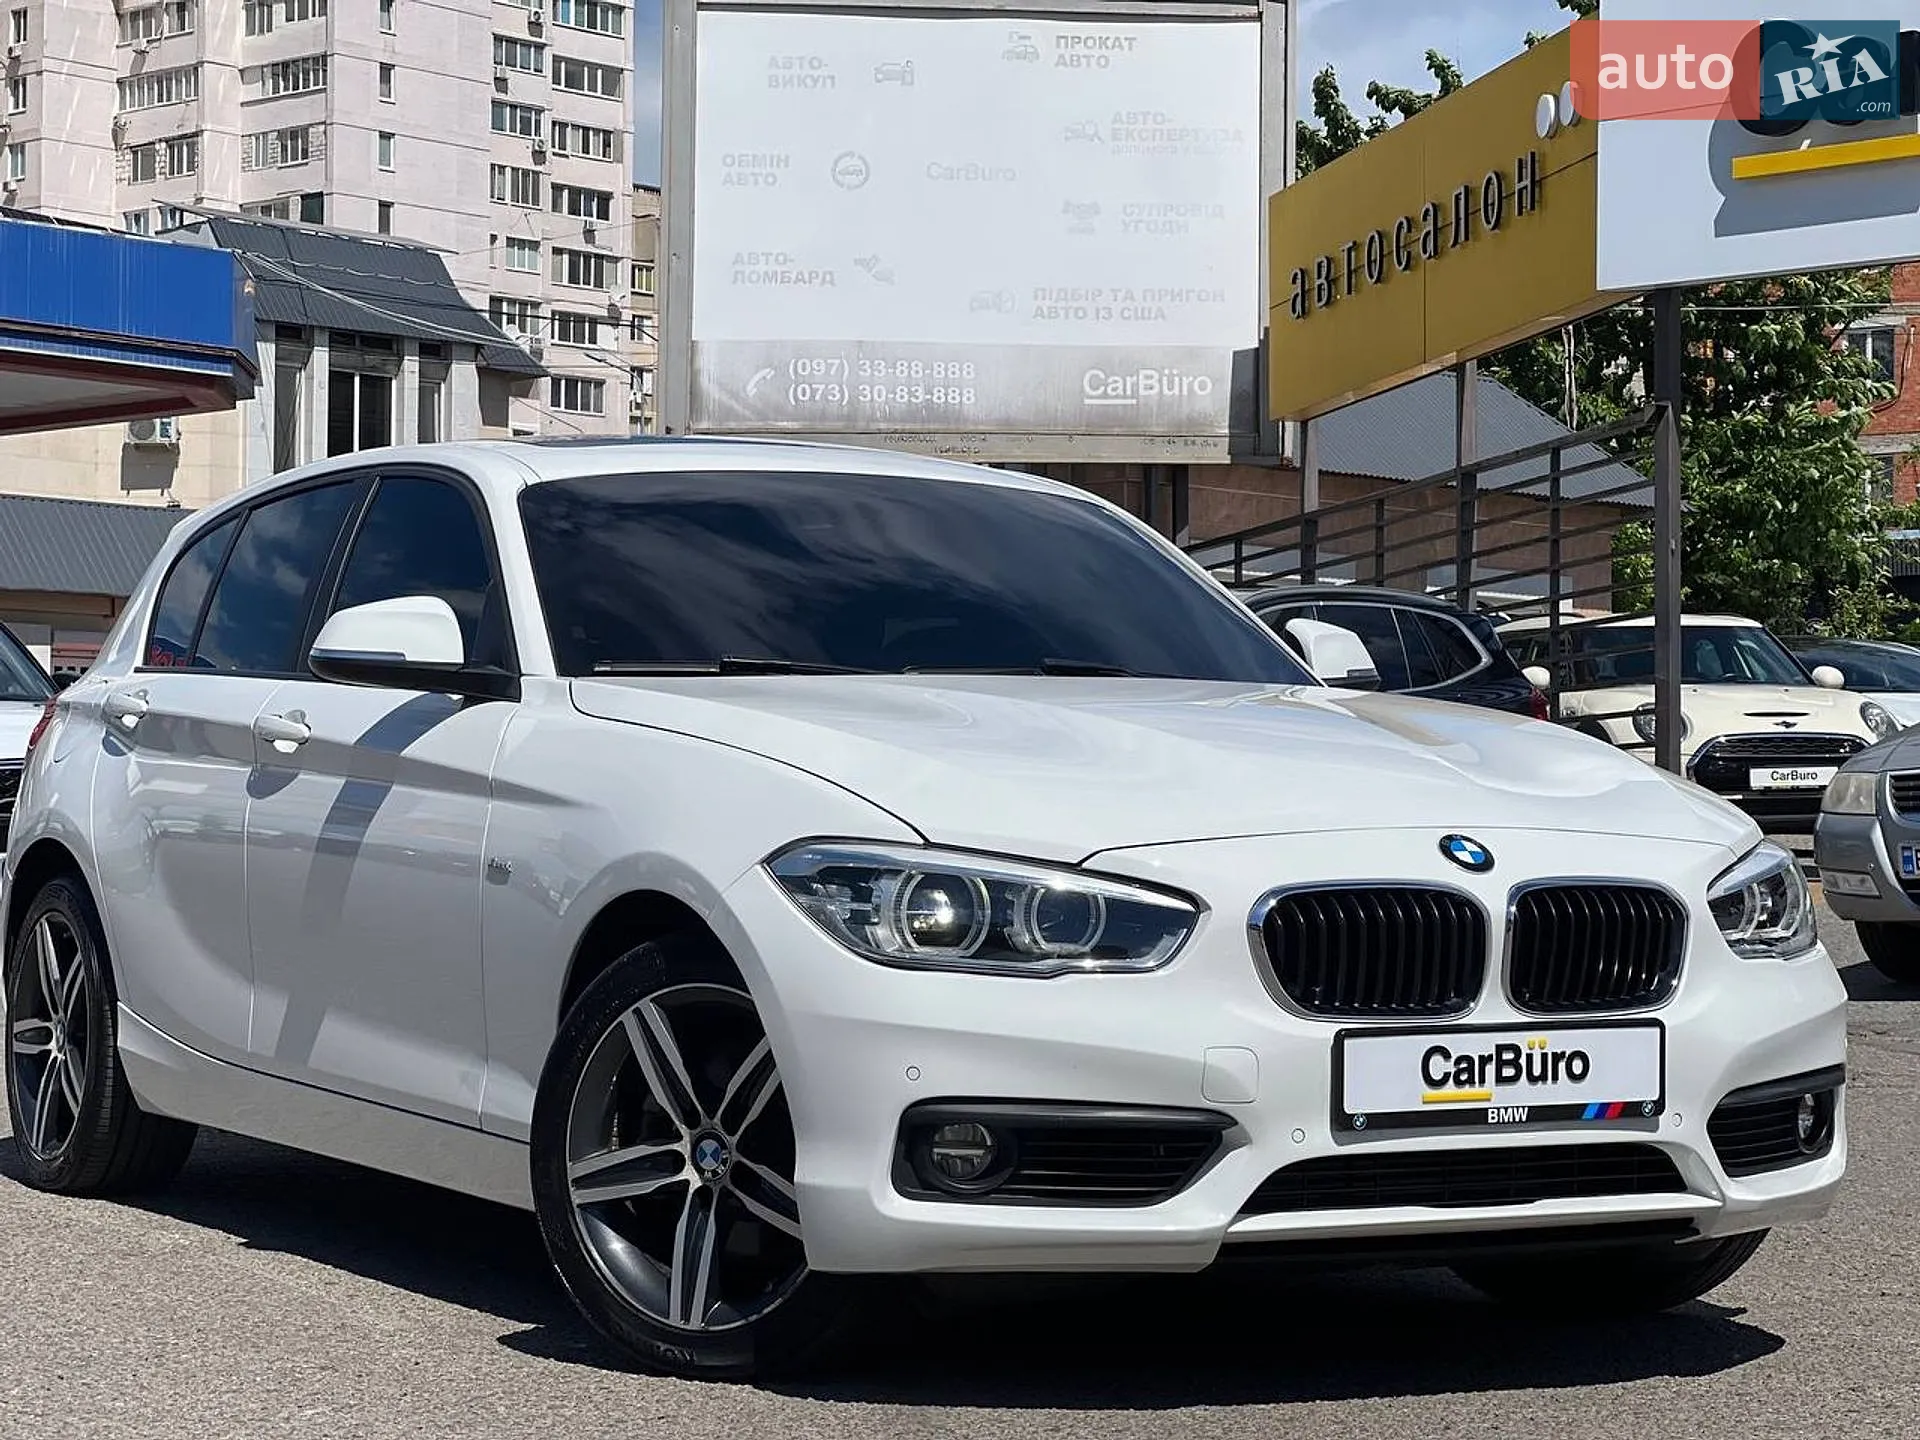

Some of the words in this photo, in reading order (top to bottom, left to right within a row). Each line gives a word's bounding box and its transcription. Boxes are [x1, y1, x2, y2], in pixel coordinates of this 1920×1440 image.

[1055, 35, 1136, 51] ПРОКАТ
[768, 55, 829, 70] АВТО-
[1054, 54, 1110, 69] АВТО
[768, 74, 836, 89] ВИКУП
[1111, 110, 1174, 126] АВТО-
[722, 153, 789, 168] ОБМІН
[722, 172, 778, 186] АВТО
[1289, 151, 1537, 319] автосалон
[732, 252, 795, 266] АВТО-
[732, 270, 837, 287] ЛОМБАРД
[1032, 287, 1103, 303] ПІДБІР
[1110, 288, 1136, 302] ТА
[1142, 288, 1226, 303] ПРИГОН
[1032, 306, 1088, 320] АВТО
[1119, 306, 1166, 321] США
[789, 359, 849, 381] (097)
[858, 359, 975, 379] 33-88-888
[1083, 368, 1213, 396] CarBüro
[789, 383, 849, 406] (073)
[858, 384, 975, 404] 30-83-888
[1421, 1037, 1591, 1088] CarBüro
[1487, 1106, 1528, 1124] BMW
